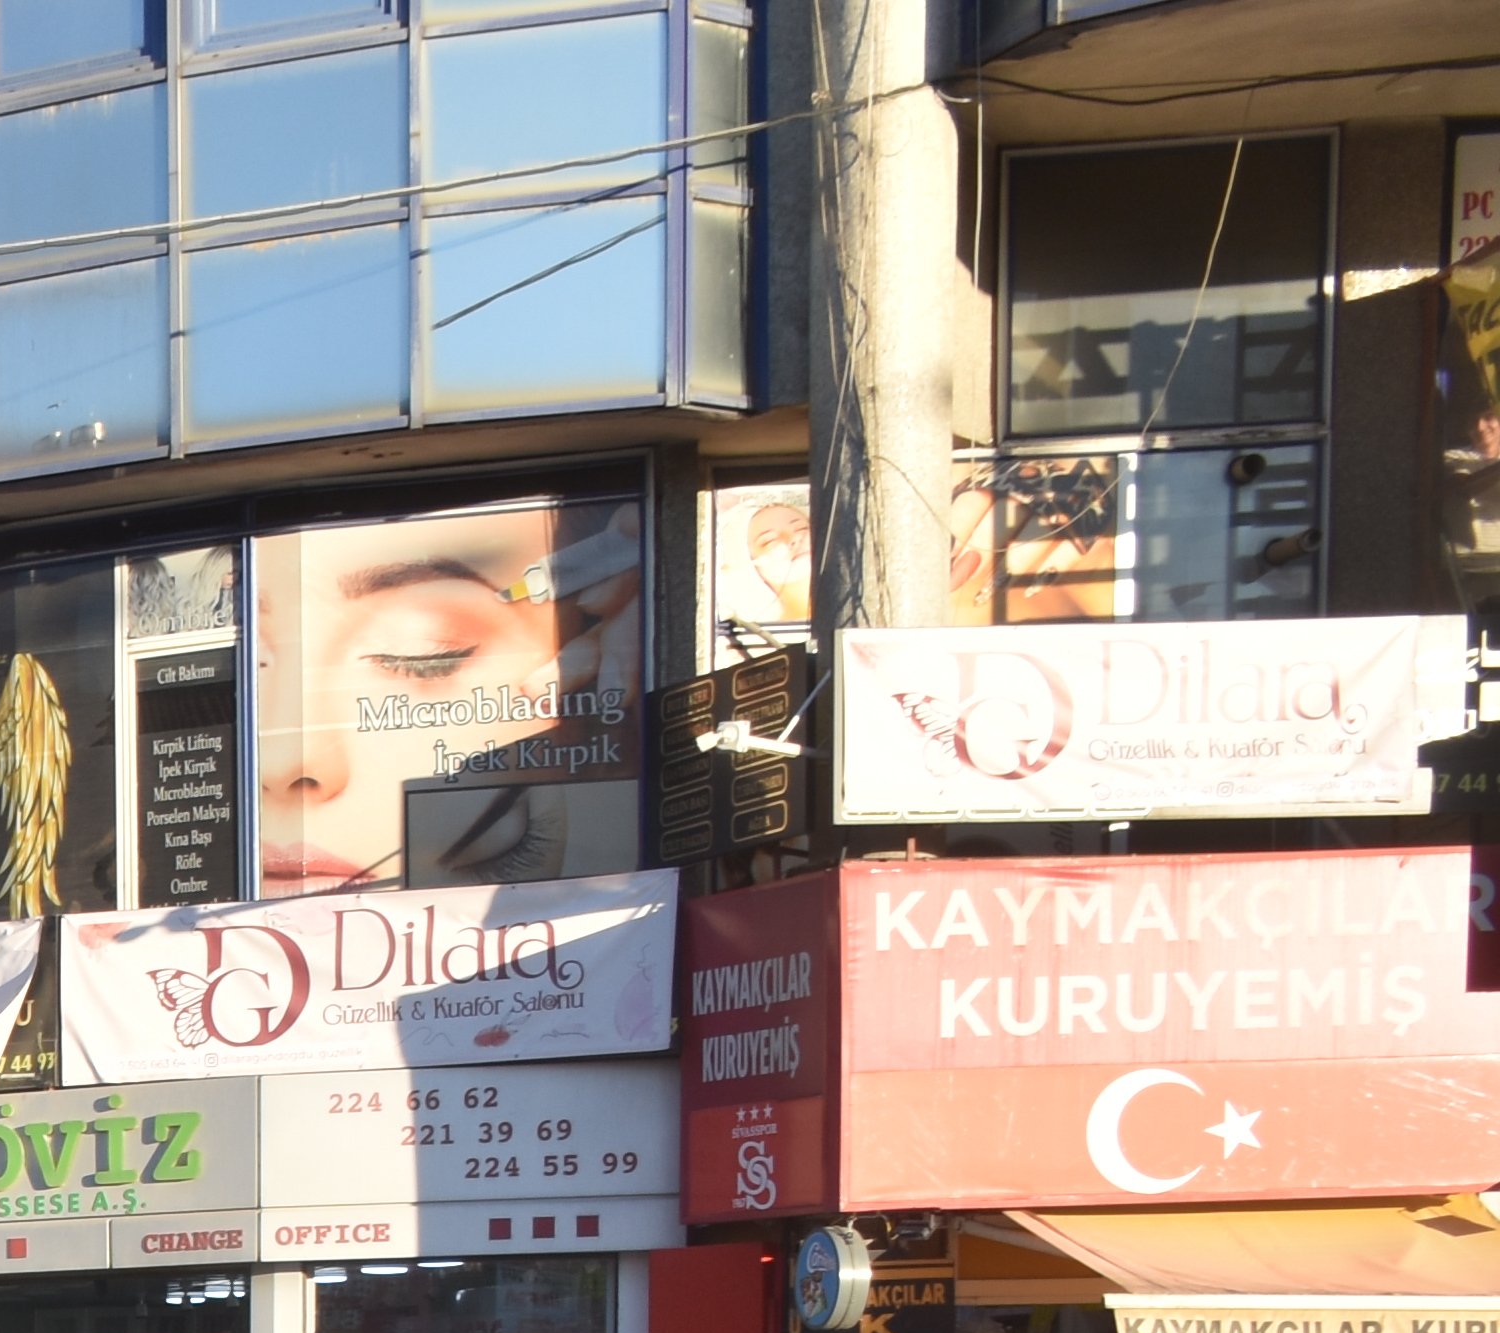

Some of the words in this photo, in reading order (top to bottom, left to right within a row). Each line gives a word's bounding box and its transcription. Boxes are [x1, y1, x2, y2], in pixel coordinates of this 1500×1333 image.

[157, 667, 176, 684] Cilt
[179, 664, 214, 681] Bakımı
[1099, 639, 1367, 734] Dilara
[153, 736, 185, 758] Kirpik
[187, 734, 222, 752] Lifting
[434, 739, 506, 784] İpek
[517, 734, 622, 773] Kirpik
[1185, 740, 1198, 758] &
[1209, 736, 1284, 758] Kuaför
[159, 759, 181, 782] İpek
[184, 757, 216, 777] Kirpik
[147, 807, 190, 827] Porselen
[193, 803, 230, 824] Makyaj
[165, 832, 189, 848] Kına
[191, 829, 212, 847] Başı
[176, 853, 202, 870] Röfle
[170, 877, 208, 894] Ombre
[875, 874, 1496, 952] KAYMAKÇILAR
[332, 906, 584, 991] Dilara
[693, 952, 811, 1016] KAYMAKÇILAR
[940, 953, 1428, 1038] KURUYEMİŞ
[412, 1000, 426, 1020] &
[434, 994, 504, 1018] Kuaför
[510, 991, 584, 1013] Salonu
[703, 1017, 800, 1082] KURUYEMİŞ
[329, 1092, 382, 1113] 224
[407, 1089, 440, 1111] 66
[464, 1087, 498, 1108] 62
[401, 1124, 454, 1146] 221
[478, 1121, 513, 1143] 39
[537, 1119, 572, 1141] 69
[465, 1157, 520, 1178] 224
[543, 1155, 579, 1176] 55
[603, 1152, 638, 1174] 99
[141, 1230, 243, 1254] CHANGE
[275, 1223, 391, 1246] OFFICE
